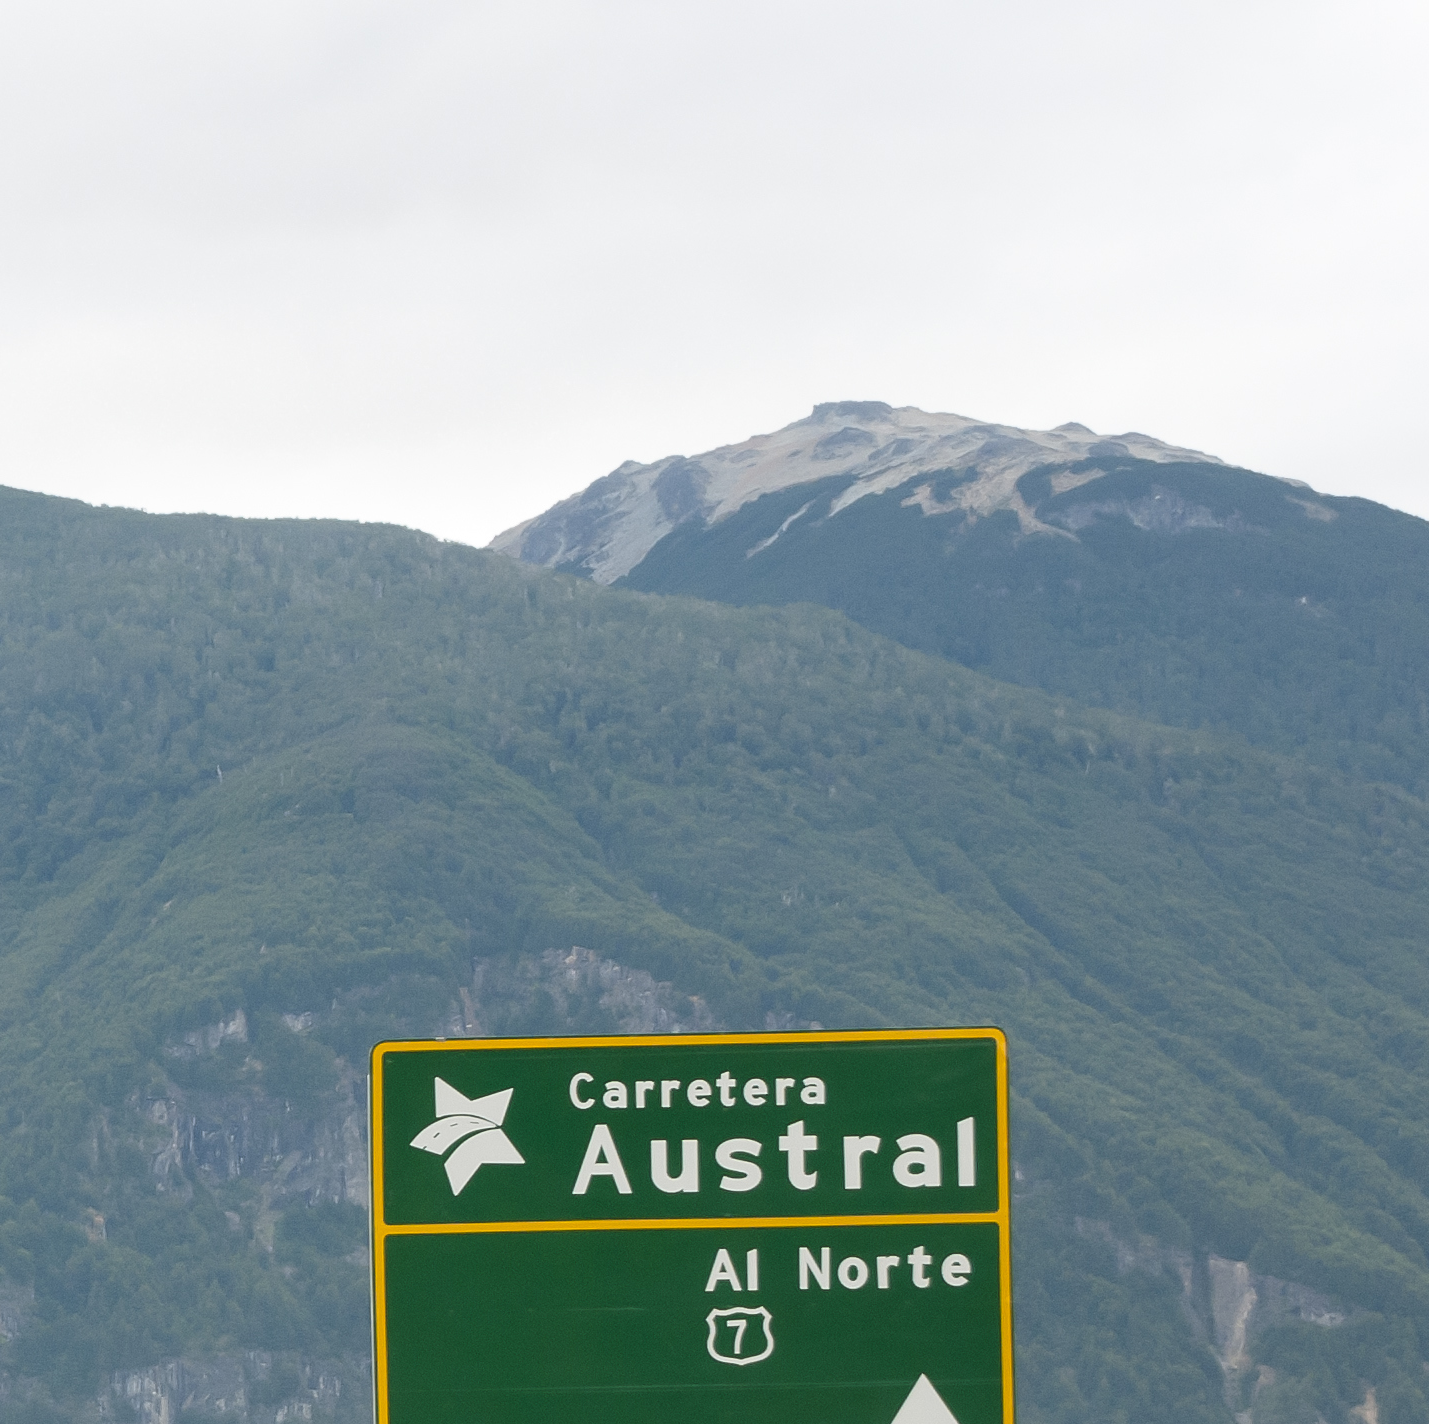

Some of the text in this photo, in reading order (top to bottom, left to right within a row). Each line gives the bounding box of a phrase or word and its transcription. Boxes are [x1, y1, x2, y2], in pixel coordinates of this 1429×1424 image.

[569, 1071, 826, 1110] Carretera
[572, 1116, 975, 1196] Austral
[704, 1245, 971, 1292] Al Norte
[726, 1319, 747, 1355] 7
